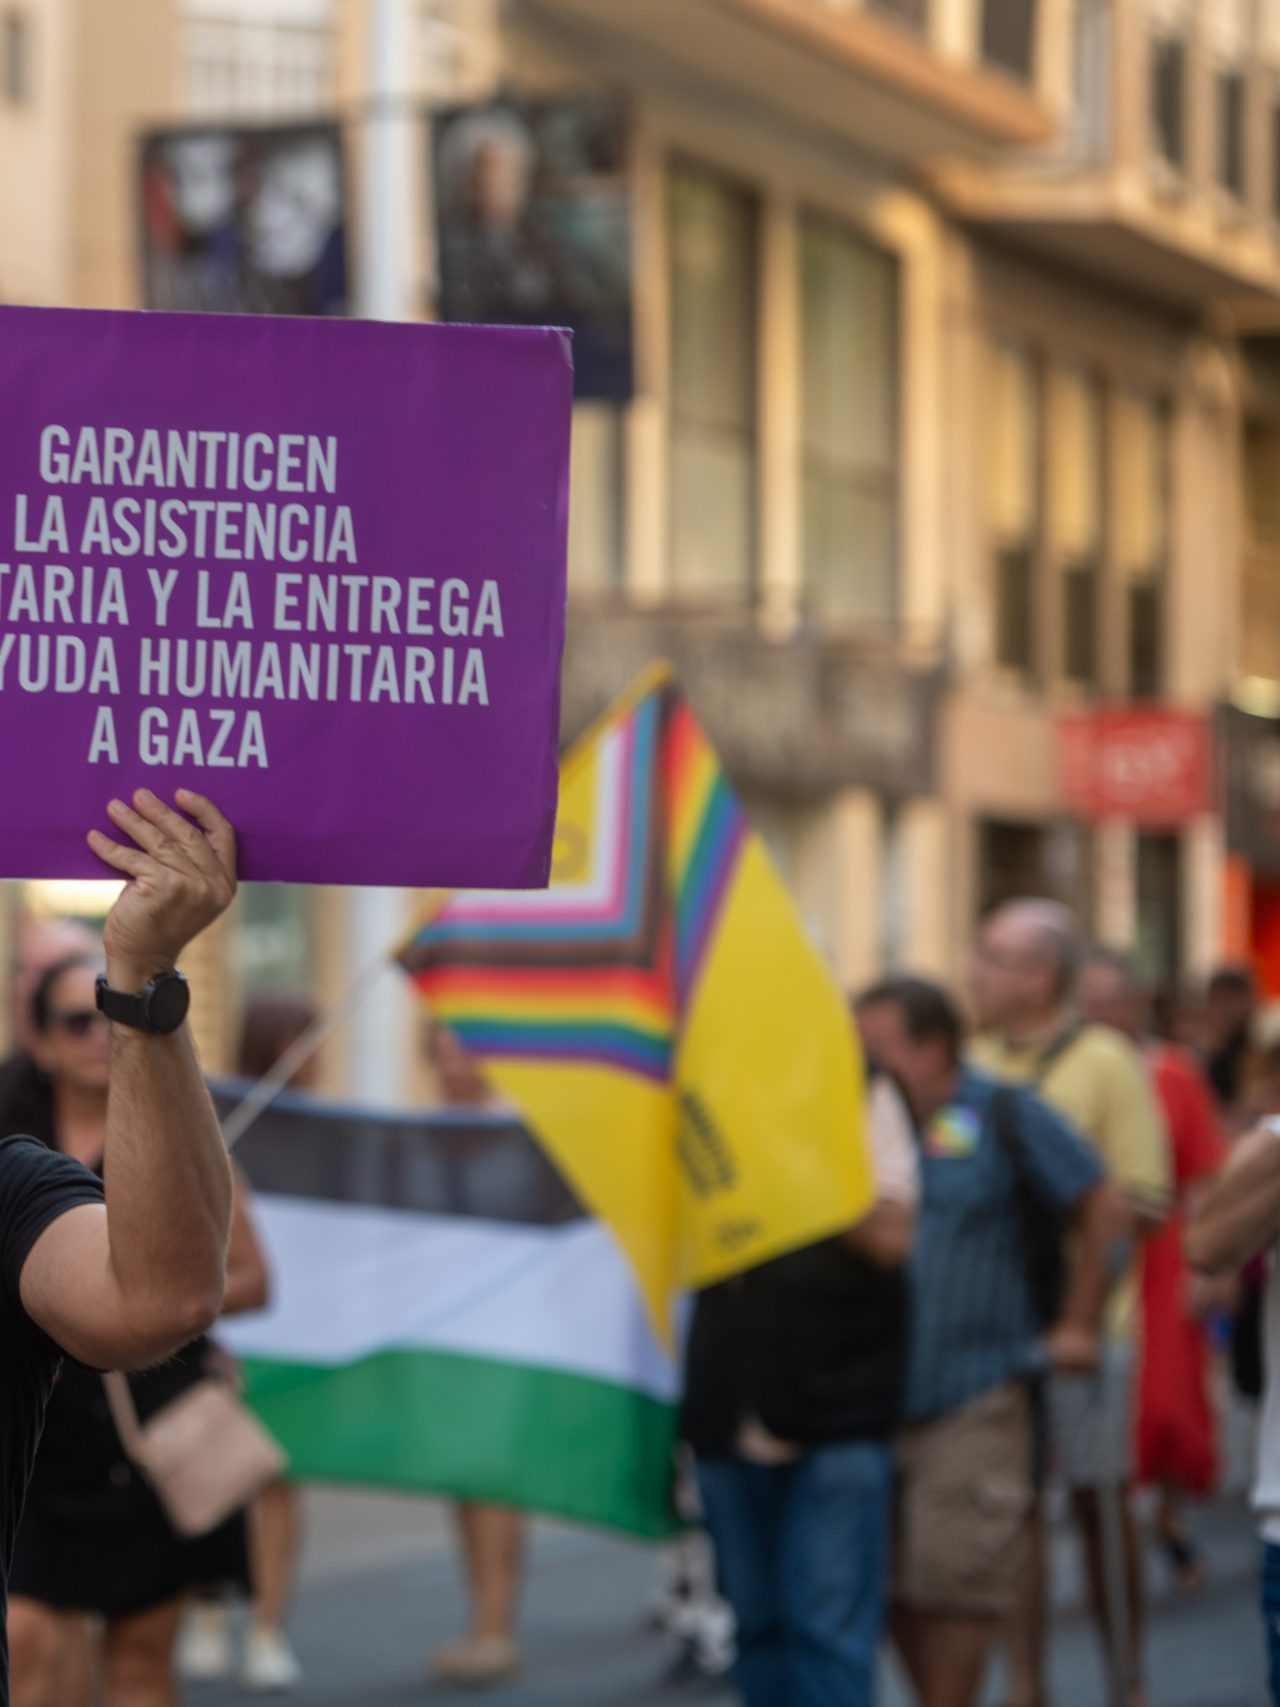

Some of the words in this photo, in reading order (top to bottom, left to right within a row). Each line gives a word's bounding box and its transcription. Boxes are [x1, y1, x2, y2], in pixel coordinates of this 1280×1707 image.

[40, 425, 337, 494] GARANTICEN
[15, 494, 69, 554] LA
[81, 497, 357, 564] ASISTENCIA
[148, 568, 179, 627] Y
[197, 570, 254, 629] LA
[274, 573, 504, 637] ENTREGA
[140, 637, 489, 706] HUMANITARIA
[88, 705, 119, 764] A
[139, 707, 269, 768] GAZA
